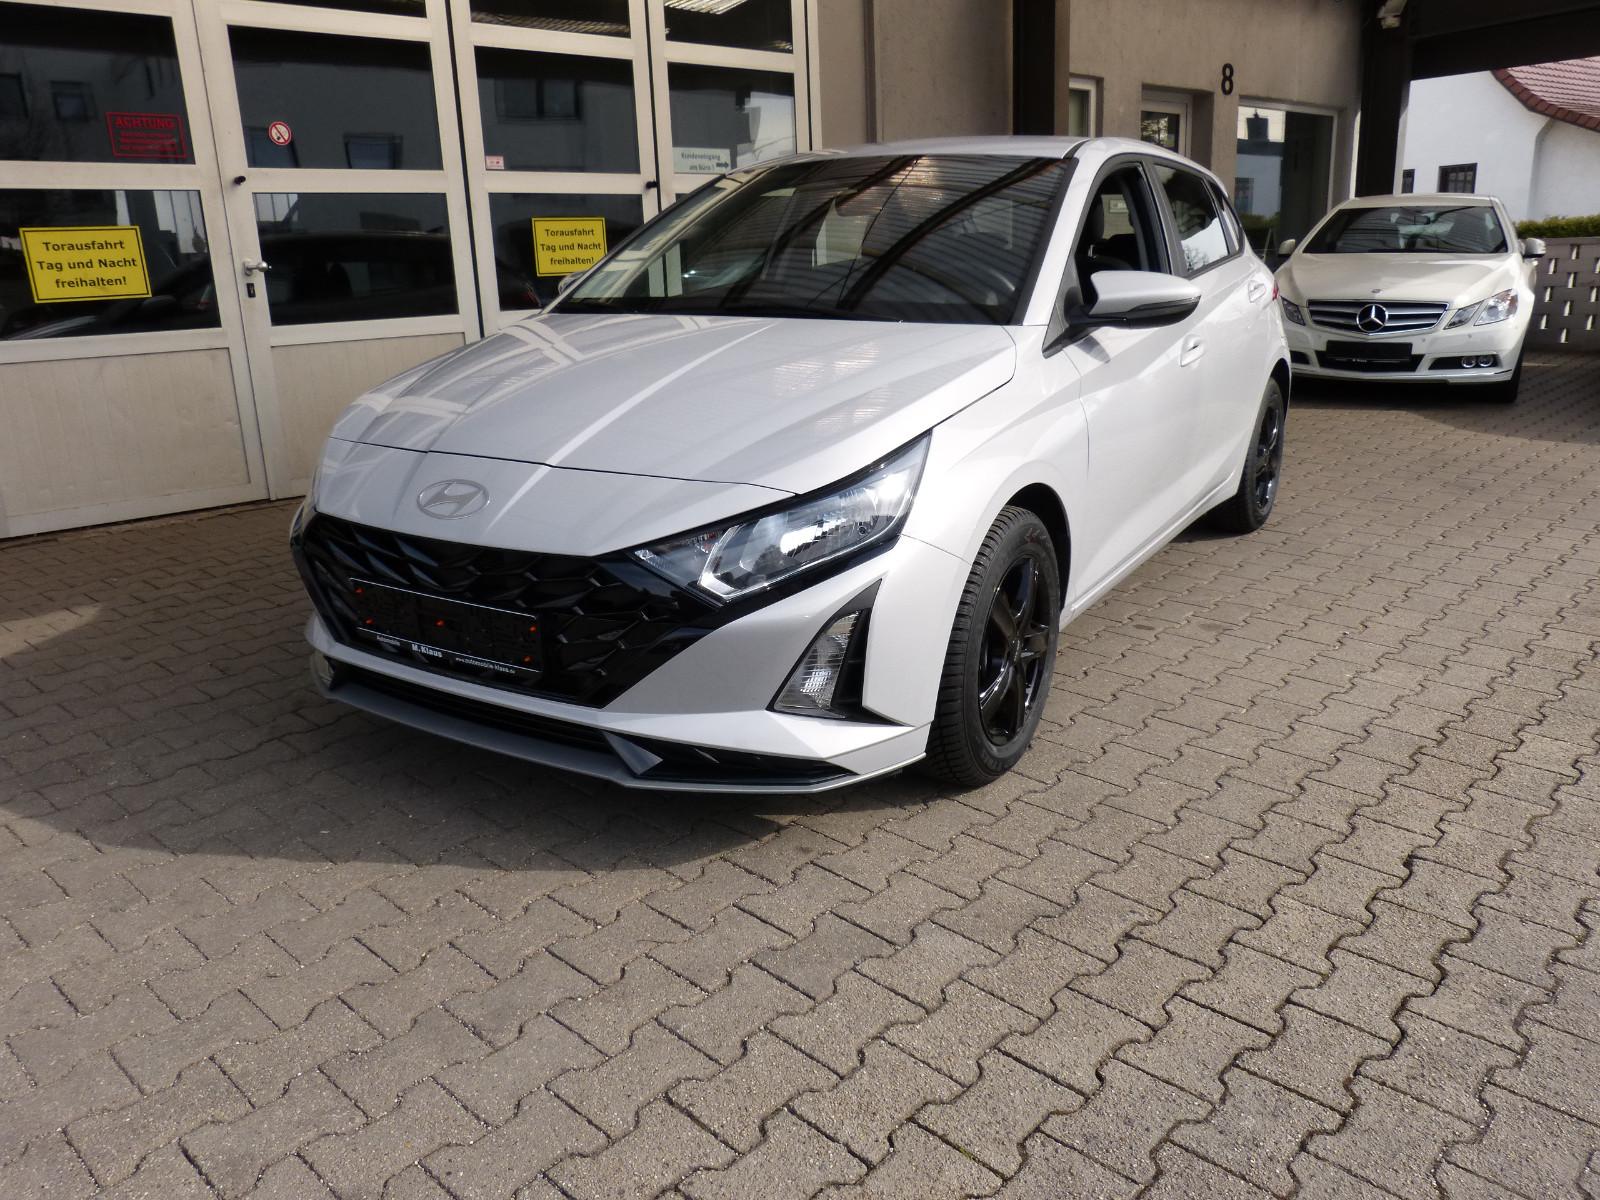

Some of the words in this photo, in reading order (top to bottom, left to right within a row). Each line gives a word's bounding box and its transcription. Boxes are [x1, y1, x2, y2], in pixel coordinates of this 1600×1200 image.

[1221, 63, 1234, 95] 8
[114, 117, 175, 129] ACHTUNG
[545, 228, 595, 237] Torausfahrt
[42, 239, 125, 252] Torausfahrt
[540, 243, 556, 253] Tag
[559, 242, 575, 251] und
[577, 242, 602, 250] Nacht
[37, 260, 63, 272] Tag
[68, 259, 94, 269] und
[98, 257, 137, 269] Nacht
[550, 256, 594, 265] freihalten!
[55, 276, 127, 289] freihalten!
